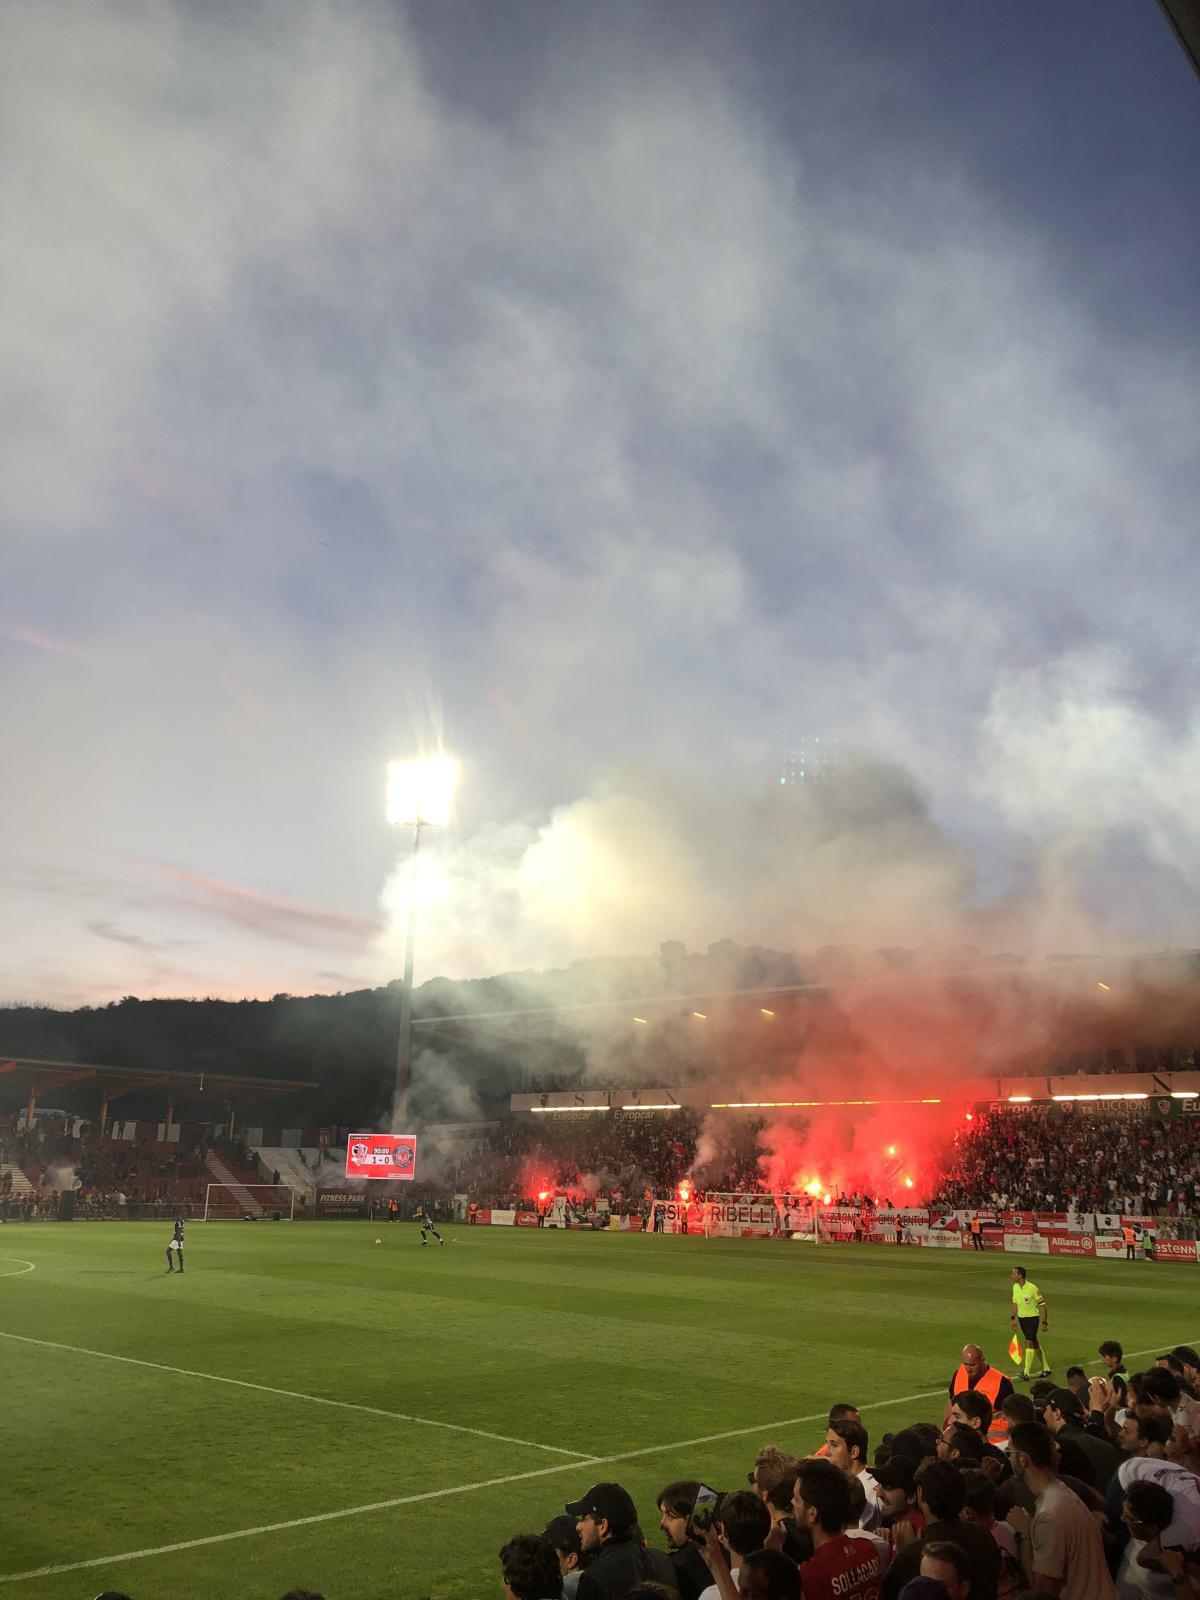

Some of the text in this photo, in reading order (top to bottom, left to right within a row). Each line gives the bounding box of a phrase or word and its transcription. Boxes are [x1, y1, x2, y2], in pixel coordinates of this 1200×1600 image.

[552, 1111, 592, 1121] Europcar
[614, 1110, 656, 1120] Europcar
[320, 1194, 366, 1202] FITNESS PARK
[711, 1205, 775, 1224] RIBELLI
[1052, 1237, 1080, 1247] Allianz
